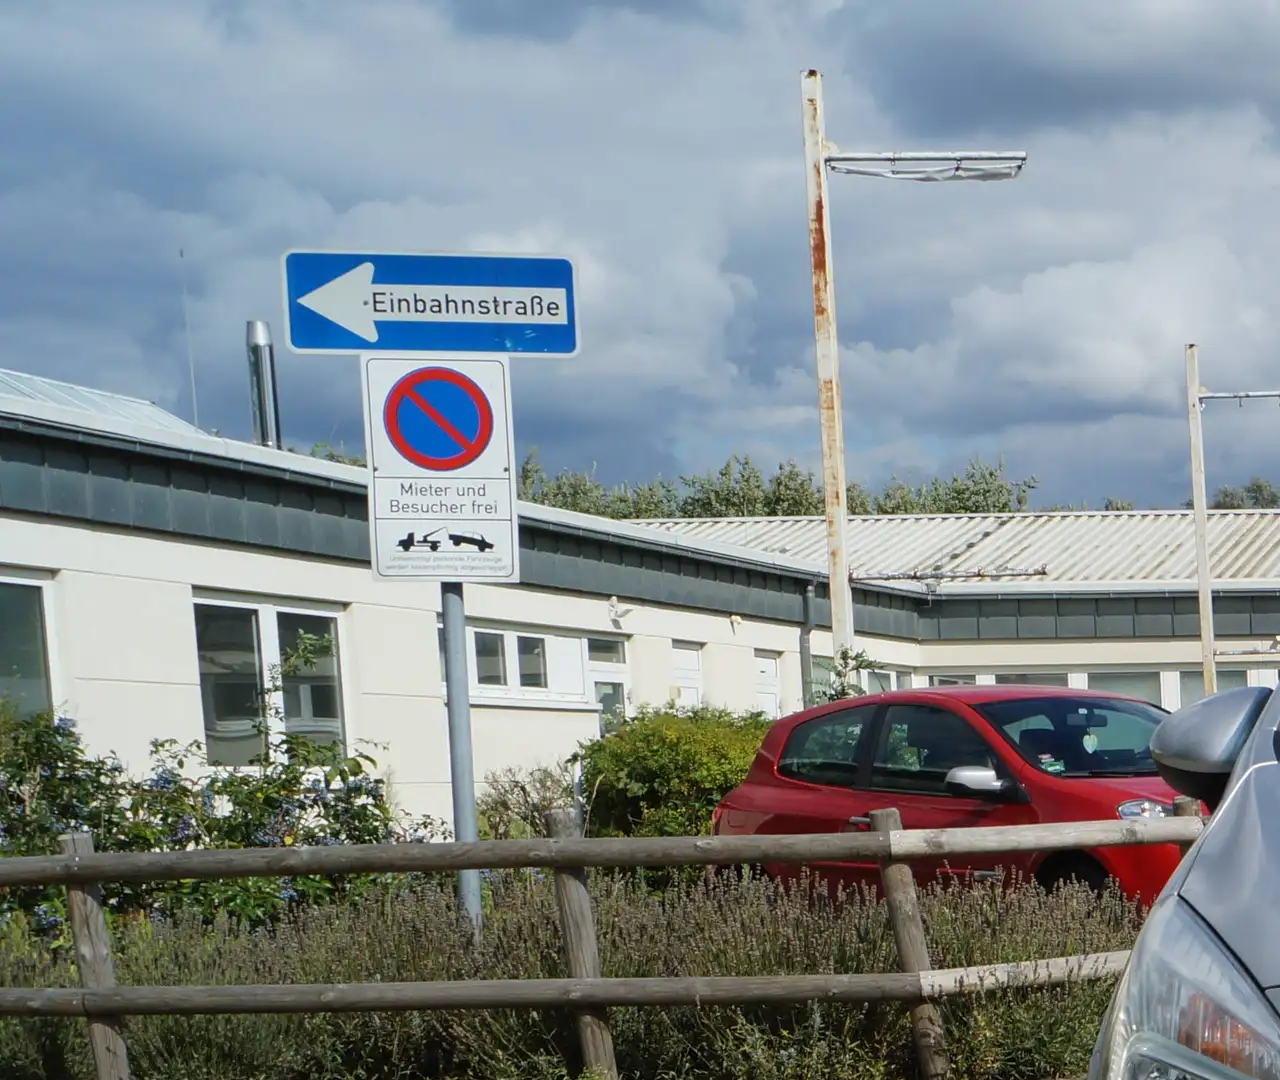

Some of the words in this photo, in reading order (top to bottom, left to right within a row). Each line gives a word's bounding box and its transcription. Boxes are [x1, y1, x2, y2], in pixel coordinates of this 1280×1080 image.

[372, 291, 560, 316] Einbahnstraße
[400, 482, 451, 497] Mieter
[456, 483, 486, 497] und
[389, 499, 466, 514] Besucher
[472, 500, 498, 514] frei
